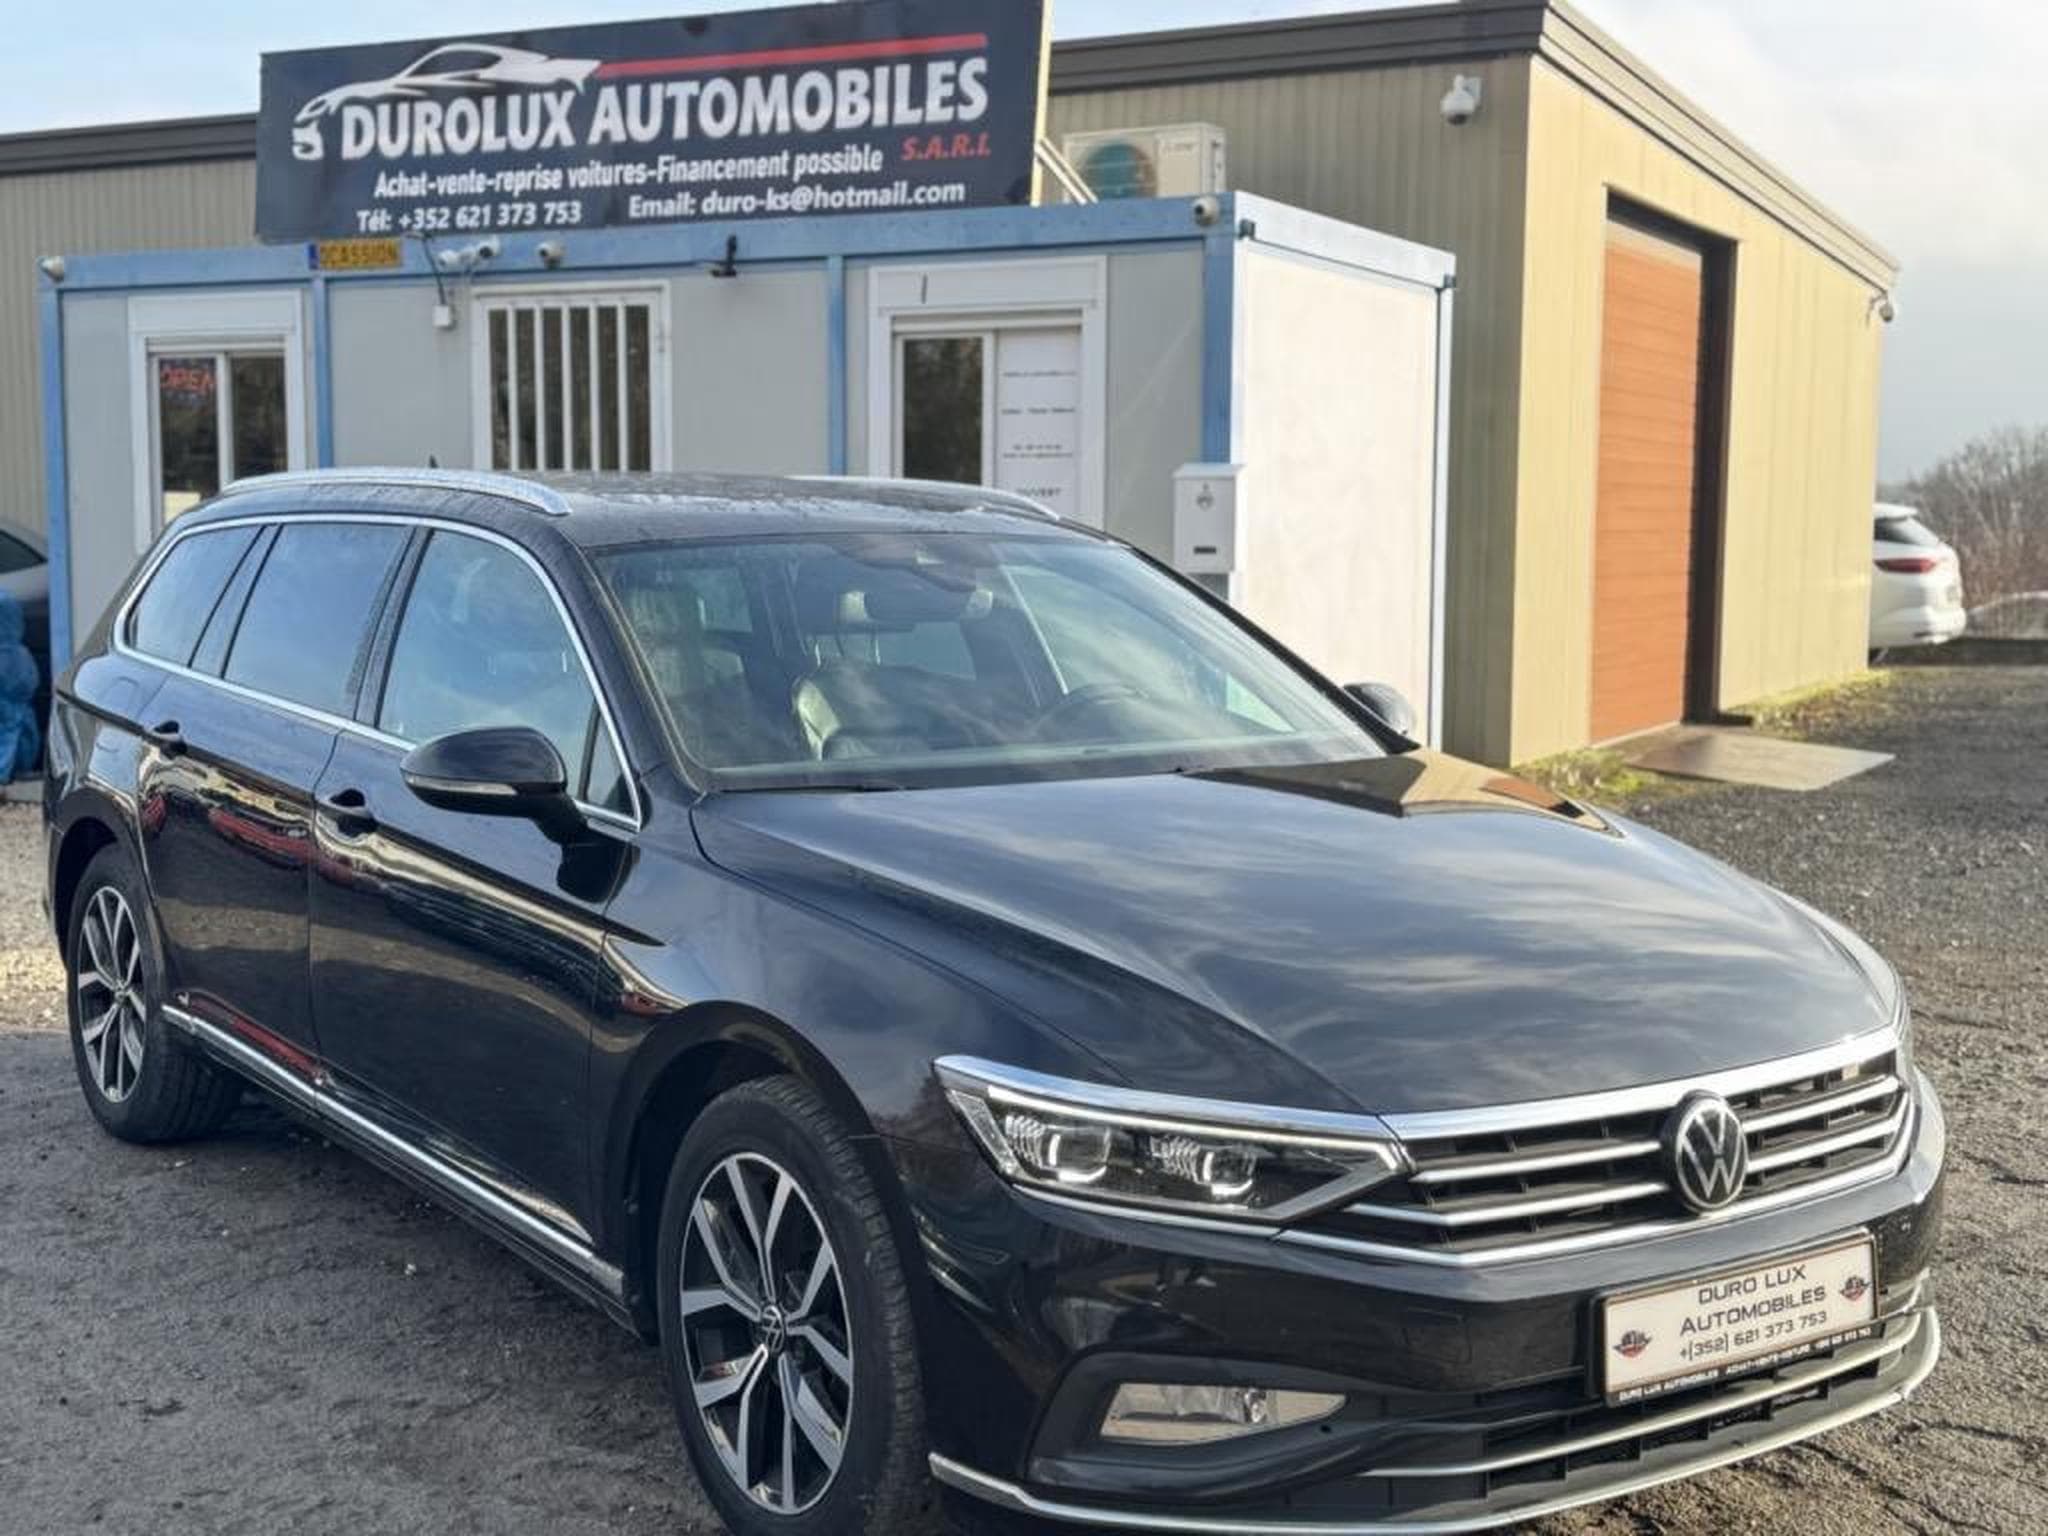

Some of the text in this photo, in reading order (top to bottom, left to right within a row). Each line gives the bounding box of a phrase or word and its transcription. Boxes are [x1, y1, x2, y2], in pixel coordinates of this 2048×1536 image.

[341, 56, 988, 161] DUROLUX AUTOMOBILES
[373, 142, 884, 198] Achat-vente-reprise voitures-Financement possible
[356, 180, 966, 233] Tél: +352 621 373 753 Email: duro-ks@hotmail.com
[1698, 1264, 1808, 1304] DURO LUX
[1679, 1286, 1827, 1336] AUTOMOBILES
[1733, 1329, 1760, 1346] 621
[1765, 1318, 1795, 1339] 373
[1799, 1310, 1828, 1329] 753
